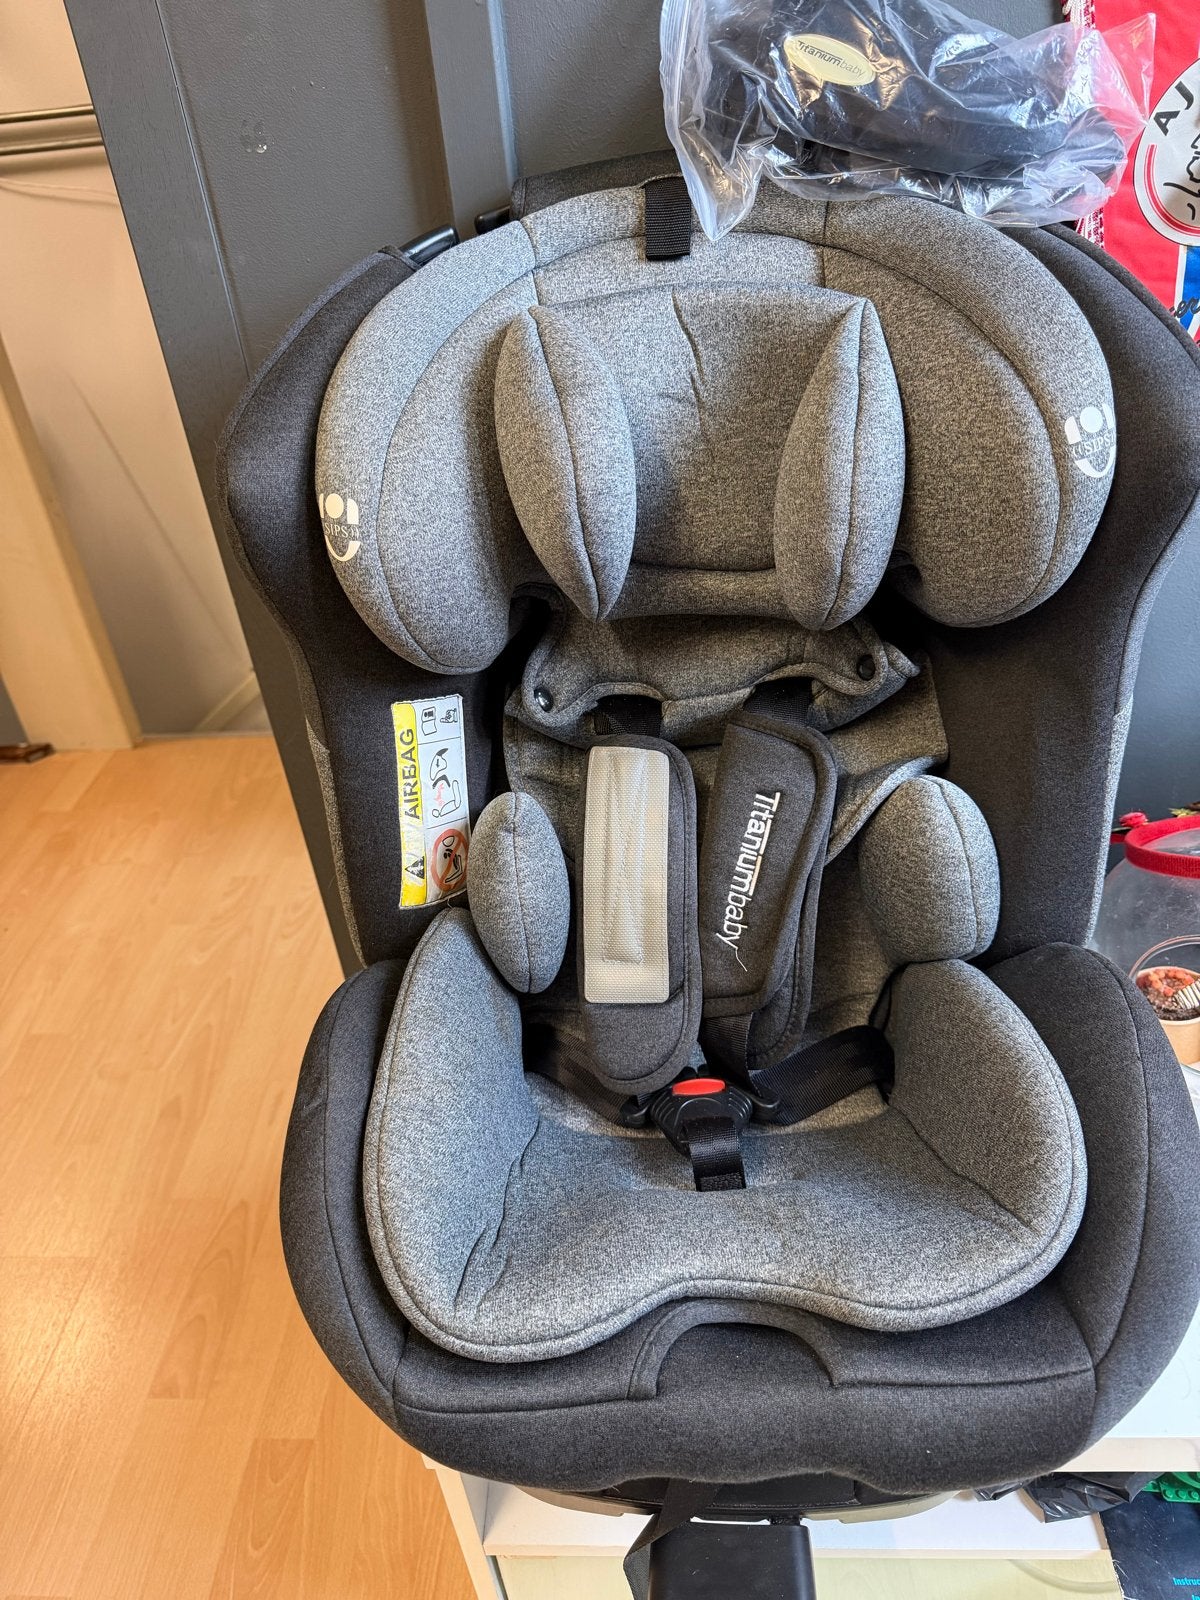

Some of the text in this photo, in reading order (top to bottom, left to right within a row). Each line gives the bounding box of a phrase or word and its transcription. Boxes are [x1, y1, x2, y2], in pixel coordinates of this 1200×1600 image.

[798, 40, 867, 78] Titaniumbaby
[399, 728, 420, 820] AIRBAG
[716, 792, 780, 952] Titaniumbaby
